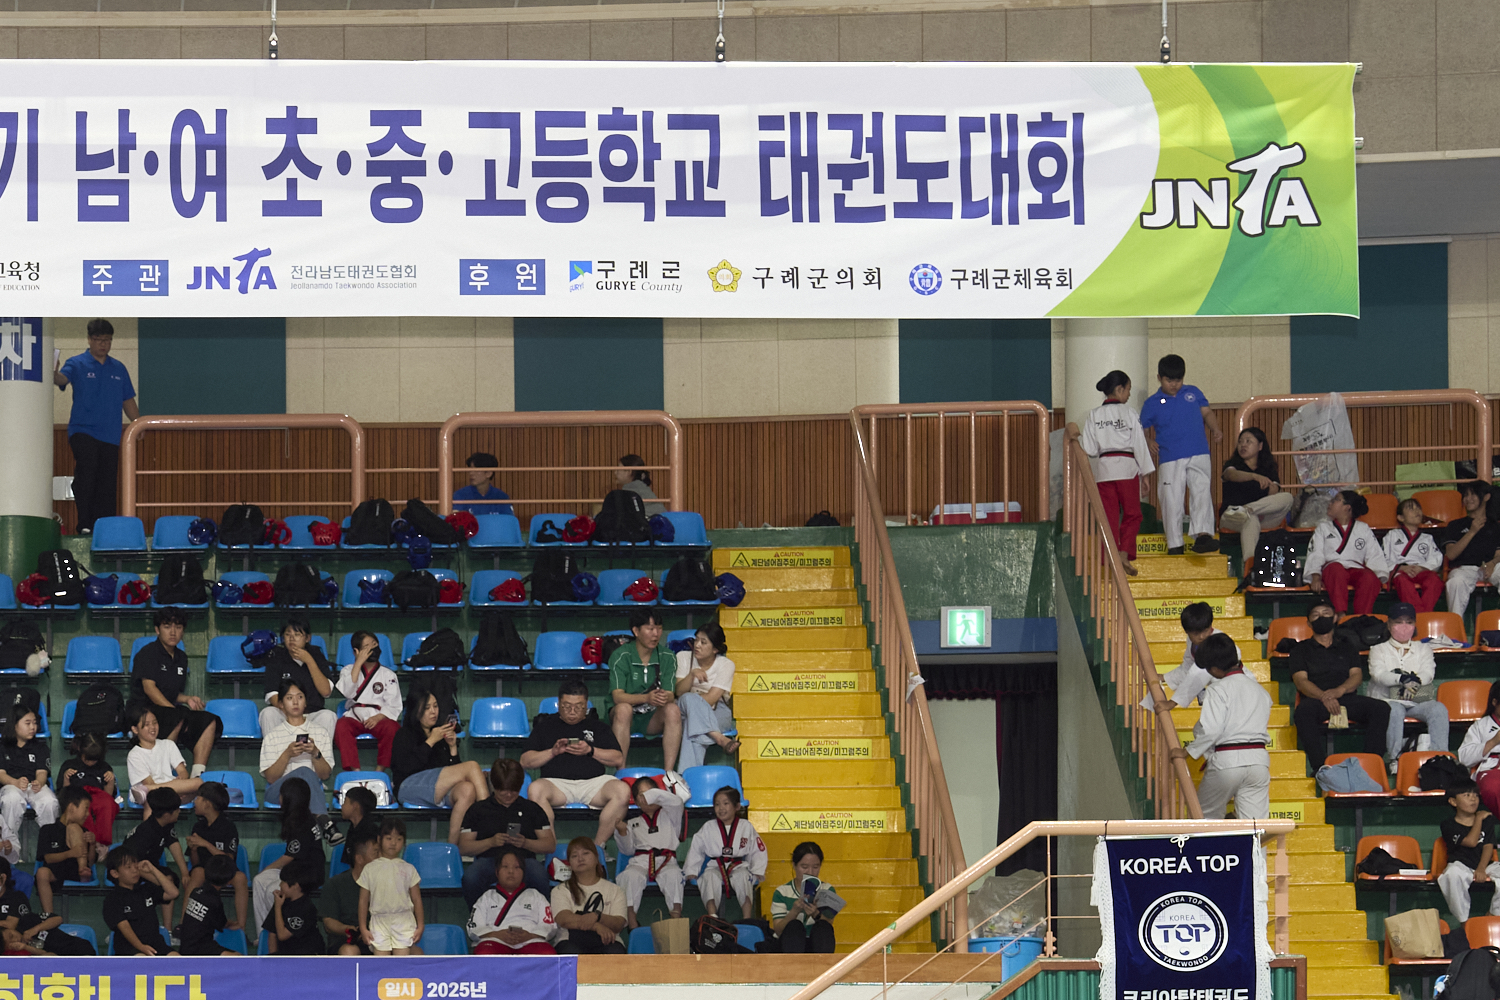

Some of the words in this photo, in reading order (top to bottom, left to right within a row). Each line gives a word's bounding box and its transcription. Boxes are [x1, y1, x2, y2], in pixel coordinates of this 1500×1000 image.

[758, 111, 1085, 226] 태권도대회
[1140, 142, 1321, 236] JNTA
[186, 247, 277, 294] JNTA
[290, 264, 417, 280] 전라남도태권도협회
[950, 267, 1073, 291] 구례군체육회
[376, 281, 417, 289] Association
[596, 281, 636, 291] GURYE
[641, 281, 683, 293] County
[1120, 857, 1192, 875] KOREA
[1196, 855, 1239, 872] TOP
[1160, 896, 1185, 908] KOREA
[1188, 896, 1203, 906] TOP
[1169, 914, 1196, 922] KOREA
[1155, 923, 1211, 943] TOP
[1163, 955, 1208, 968] TAEKWONDO
[385, 982, 415, 998] 일시
[426, 981, 487, 998] 2025년
